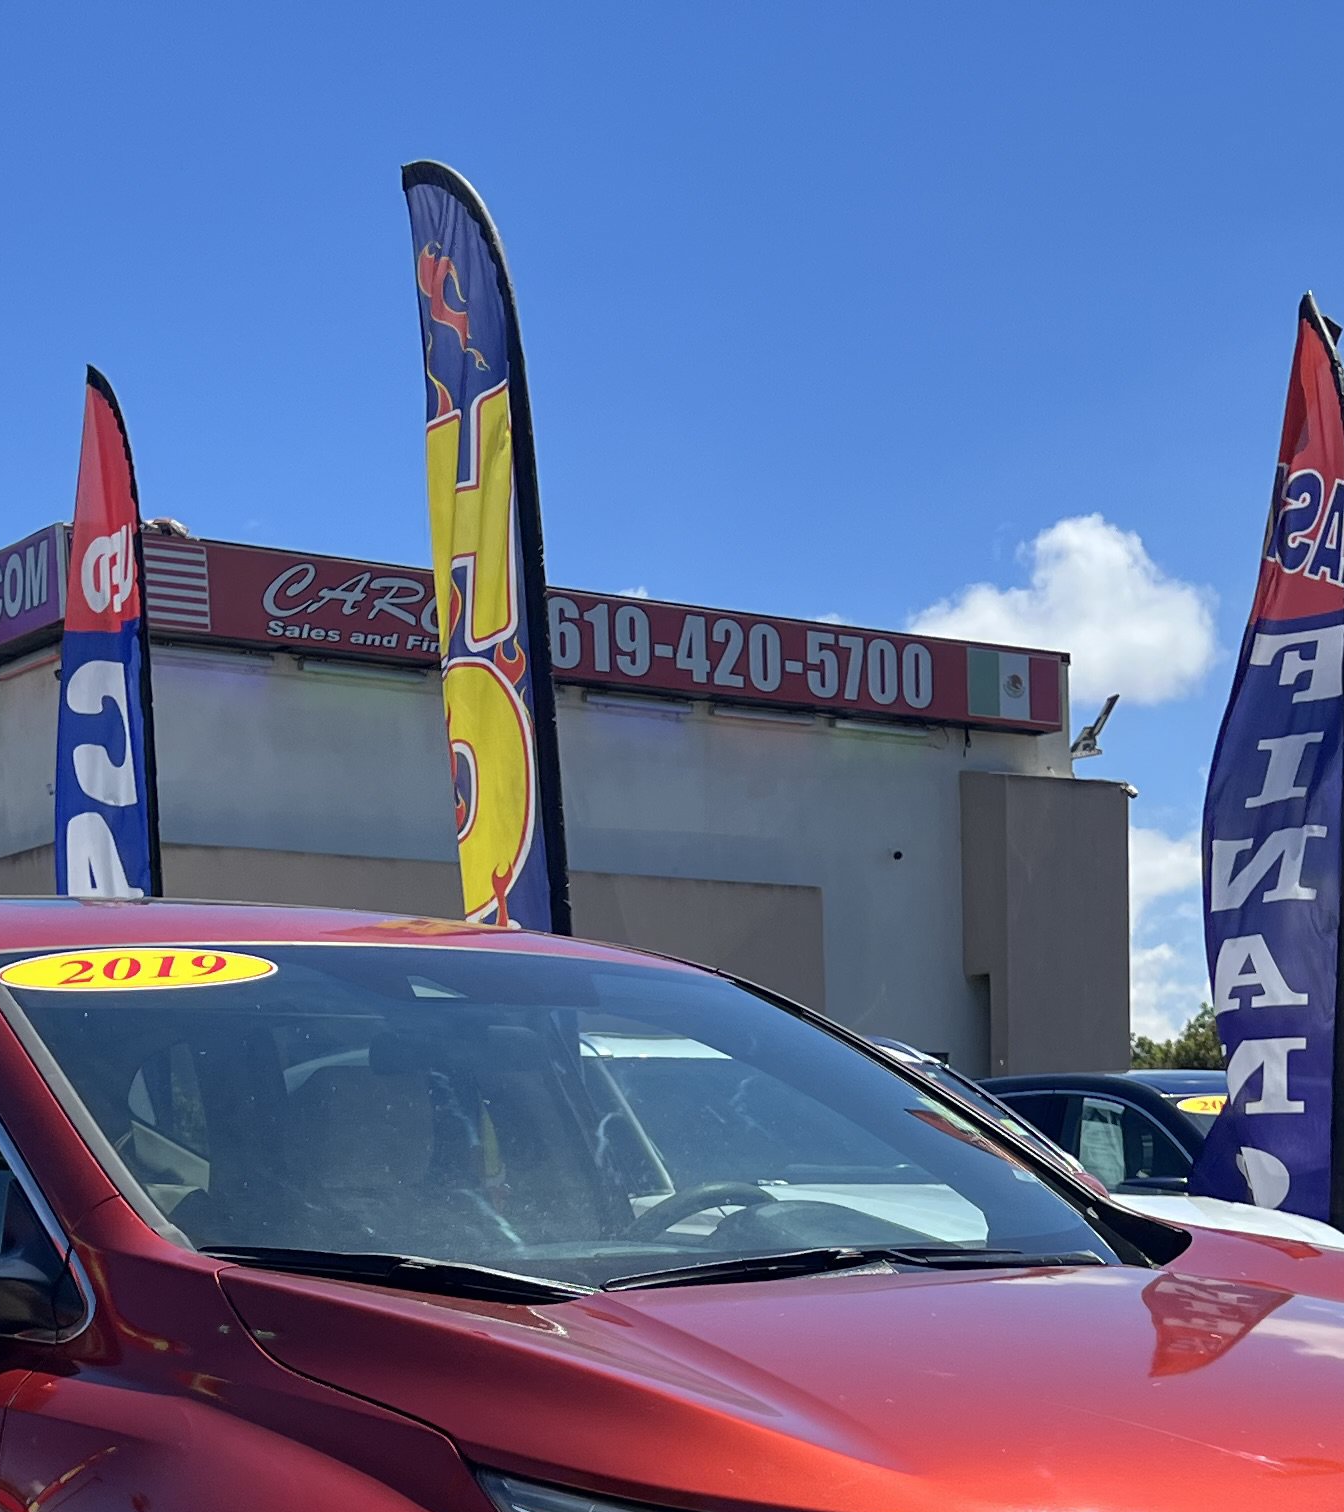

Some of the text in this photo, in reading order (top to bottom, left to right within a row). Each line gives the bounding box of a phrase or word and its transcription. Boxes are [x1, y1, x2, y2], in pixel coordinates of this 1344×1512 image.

[266, 620, 341, 642] Sales
[350, 631, 398, 648] and
[547, 596, 933, 710] 619-420-5700
[58, 954, 228, 985] 2019
